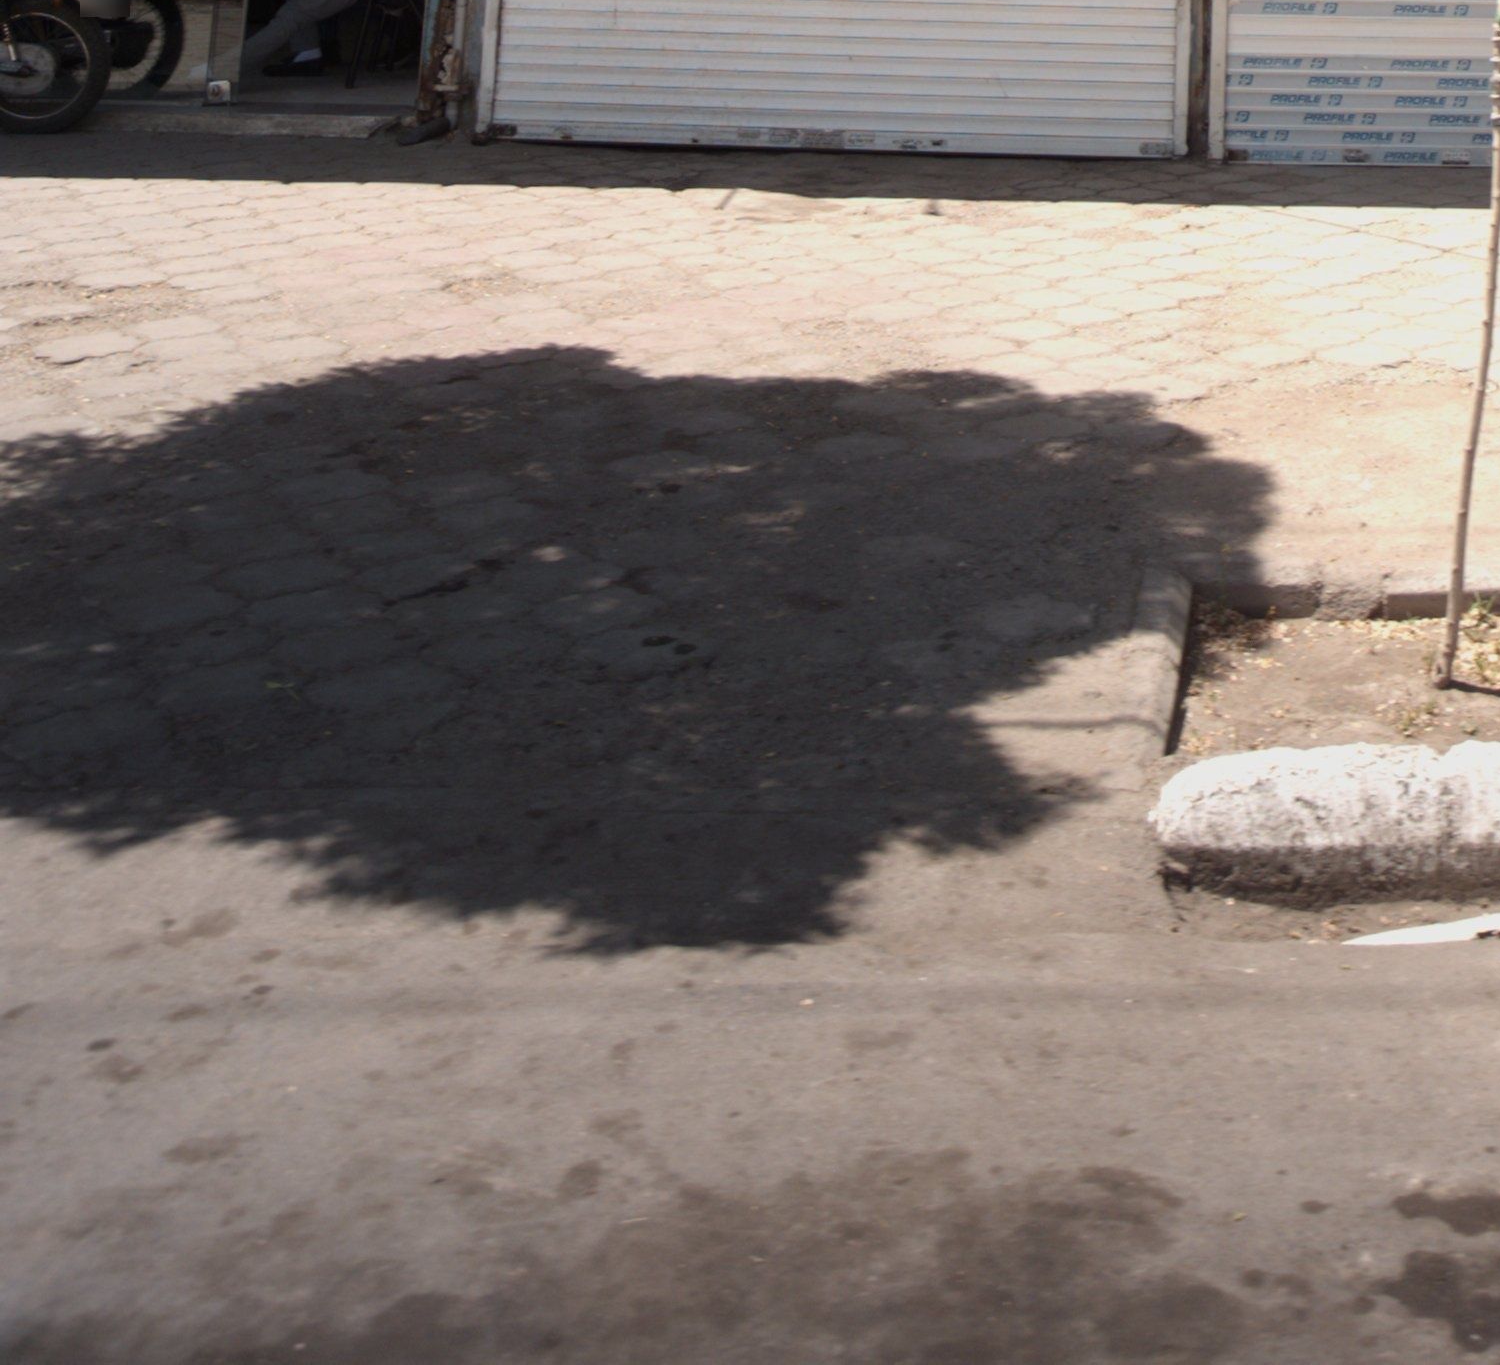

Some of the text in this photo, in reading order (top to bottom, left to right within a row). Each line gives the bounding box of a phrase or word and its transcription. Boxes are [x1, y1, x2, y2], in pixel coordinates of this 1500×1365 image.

[1263, 1, 1317, 11] PROFILE
[1393, 5, 1446, 15] PROFILE
[1271, 93, 1322, 103] PROFILE
[1396, 95, 1447, 105] PROFILE
[1305, 112, 1356, 122] PROFILE
[1430, 114, 1481, 124] PROFILE
